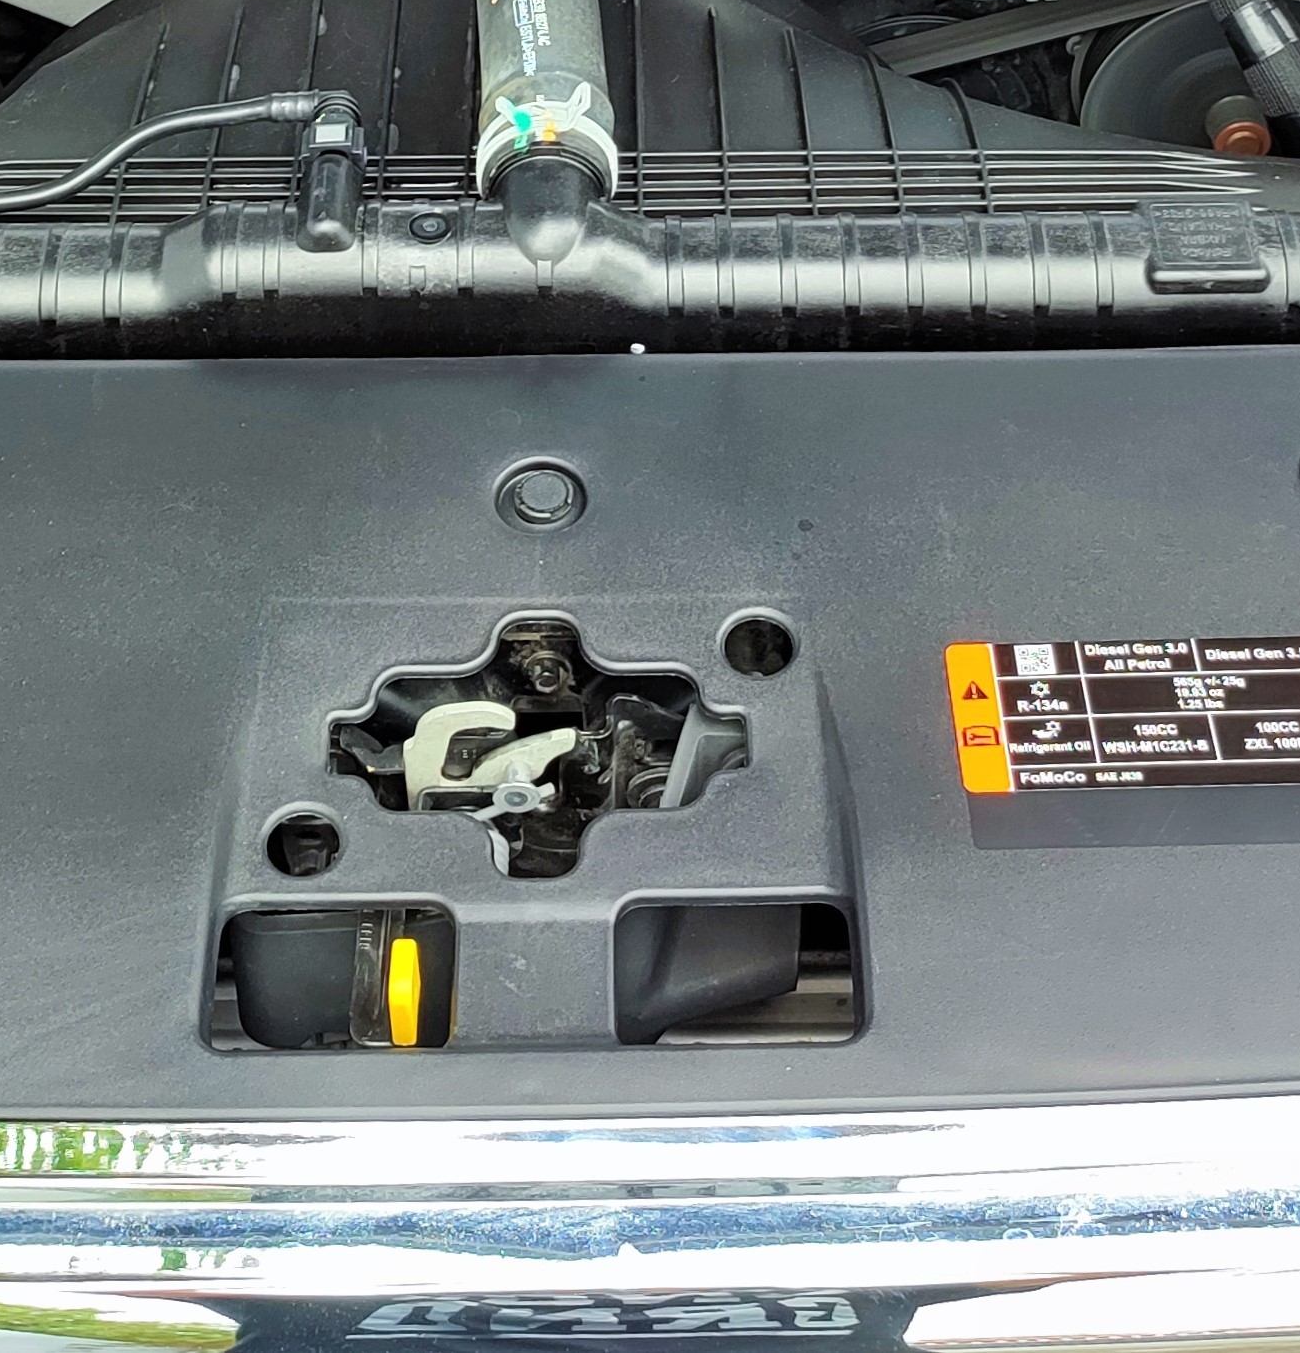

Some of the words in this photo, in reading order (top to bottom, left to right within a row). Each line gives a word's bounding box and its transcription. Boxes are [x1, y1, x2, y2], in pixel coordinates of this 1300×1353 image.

[1084, 643, 1130, 656] Diesel
[1133, 643, 1163, 655] Gen
[1165, 642, 1189, 654] 3.0
[1205, 649, 1249, 661] Diesel
[1254, 648, 1284, 660] Gen
[1104, 659, 1125, 671] All
[1127, 658, 1172, 670] Petrol
[1208, 688, 1225, 698] oz
[1017, 699, 1069, 712] R-134a
[1178, 699, 1203, 709] 1.25
[1205, 698, 1225, 709] lbs
[1133, 723, 1178, 736] 150CC
[1255, 721, 1300, 733] 100CC
[1010, 740, 1072, 754] Refrigerant
[1075, 740, 1091, 751] Oil
[1102, 740, 1209, 754] WSH-M1C231-B
[1244, 738, 1274, 750] ZXL
[1020, 771, 1087, 784] FoMoCo
[1096, 772, 1117, 782] SAE
